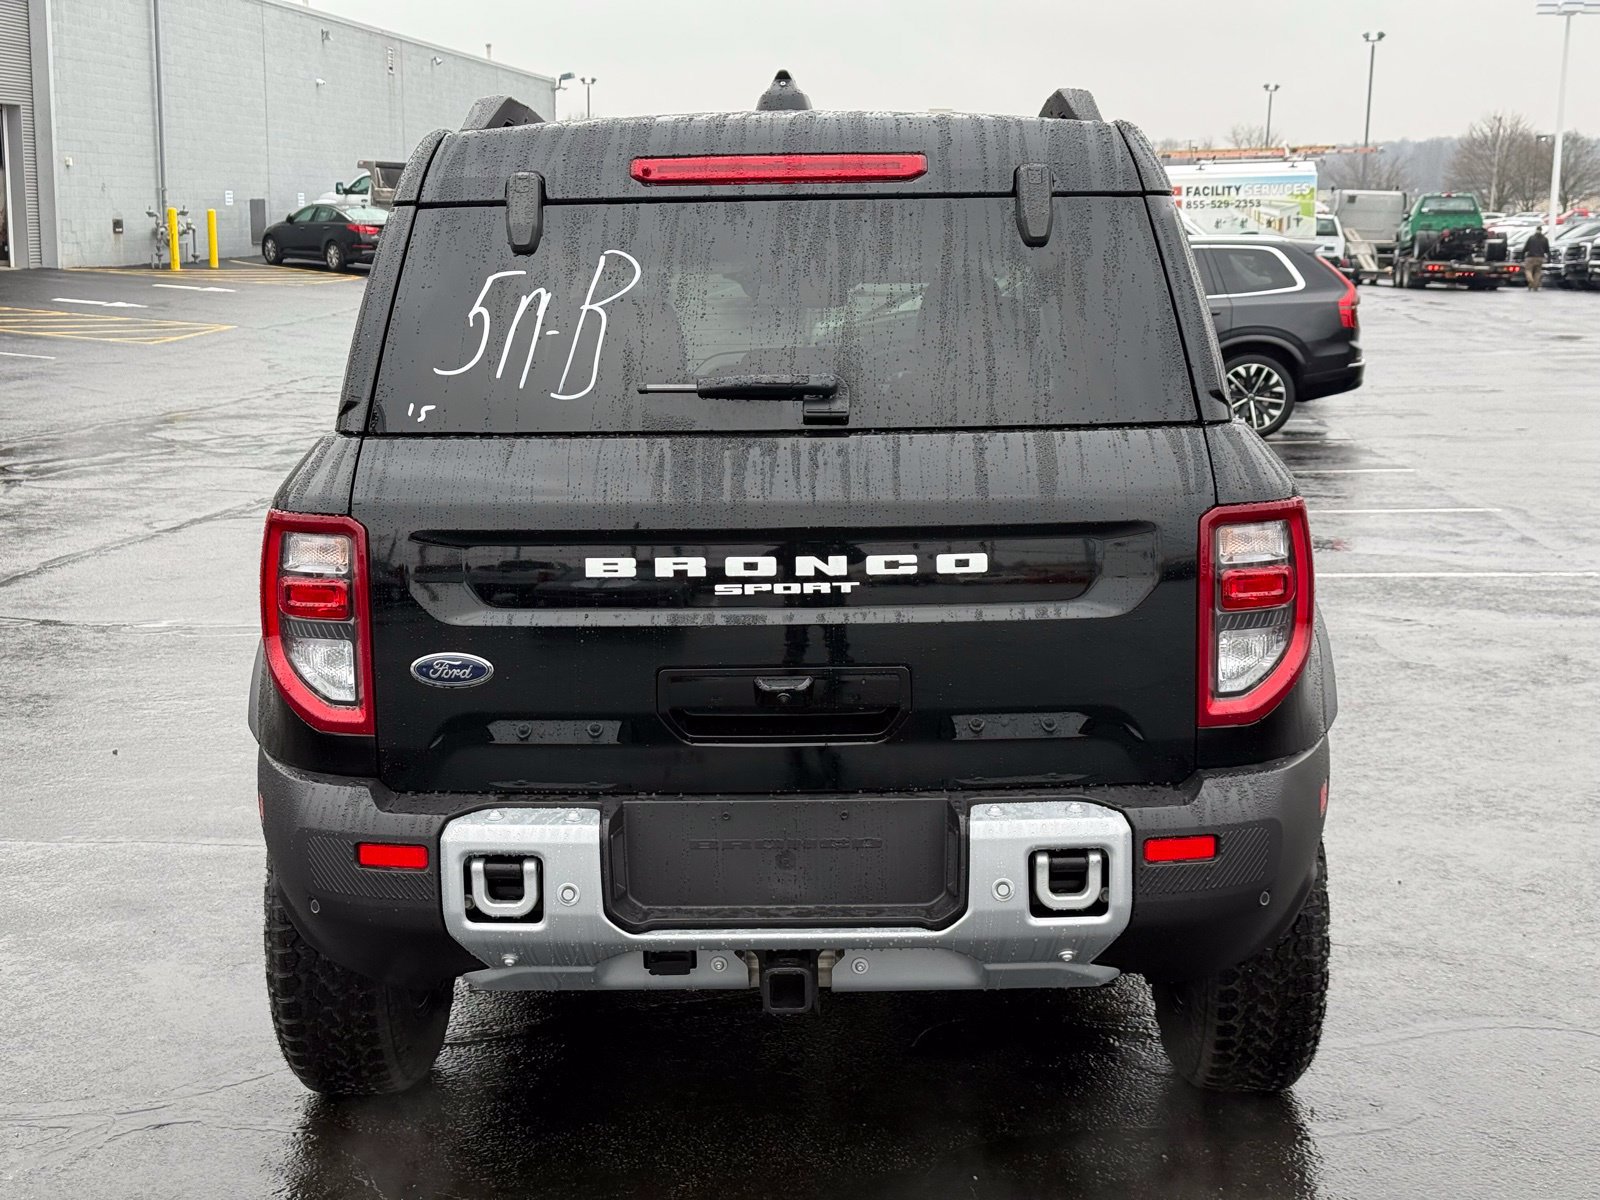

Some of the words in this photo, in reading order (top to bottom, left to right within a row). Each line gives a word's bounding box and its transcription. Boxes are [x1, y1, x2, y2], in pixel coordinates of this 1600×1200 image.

[1186, 185, 1241, 196] FACILITY
[1244, 183, 1310, 195] SERVICES
[1186, 199, 1261, 208] 855-529-2353
[585, 552, 988, 577] BRONCO
[714, 582, 860, 596] SPORT
[429, 659, 473, 679] Ford
